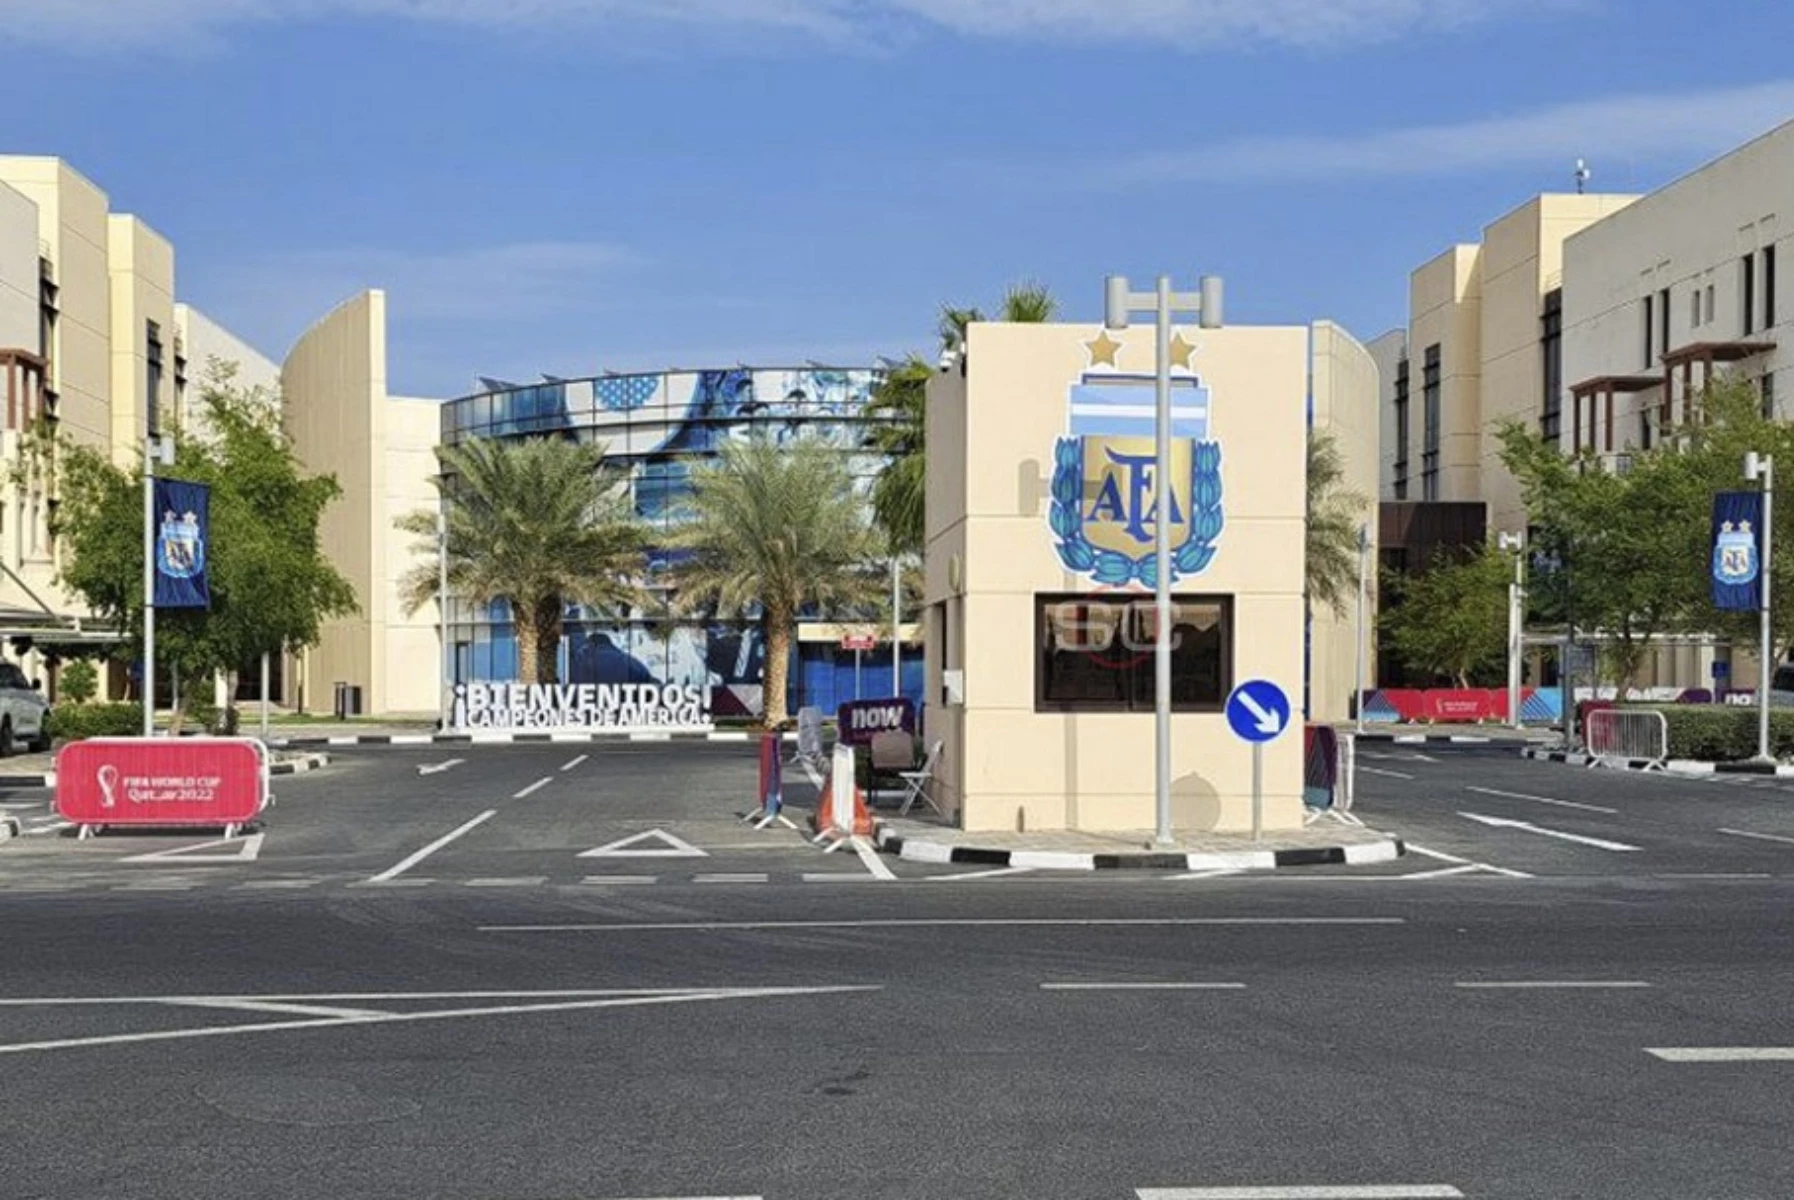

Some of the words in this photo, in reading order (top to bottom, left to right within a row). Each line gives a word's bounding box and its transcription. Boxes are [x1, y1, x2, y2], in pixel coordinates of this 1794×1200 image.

[1086, 445, 1184, 543] AFA
[468, 708, 585, 727] CAMPEONES
[590, 706, 619, 726] DE
[851, 705, 904, 729] now
[151, 777, 195, 788] WORLD
[197, 777, 221, 788] CUP
[177, 788, 214, 801] 2022
